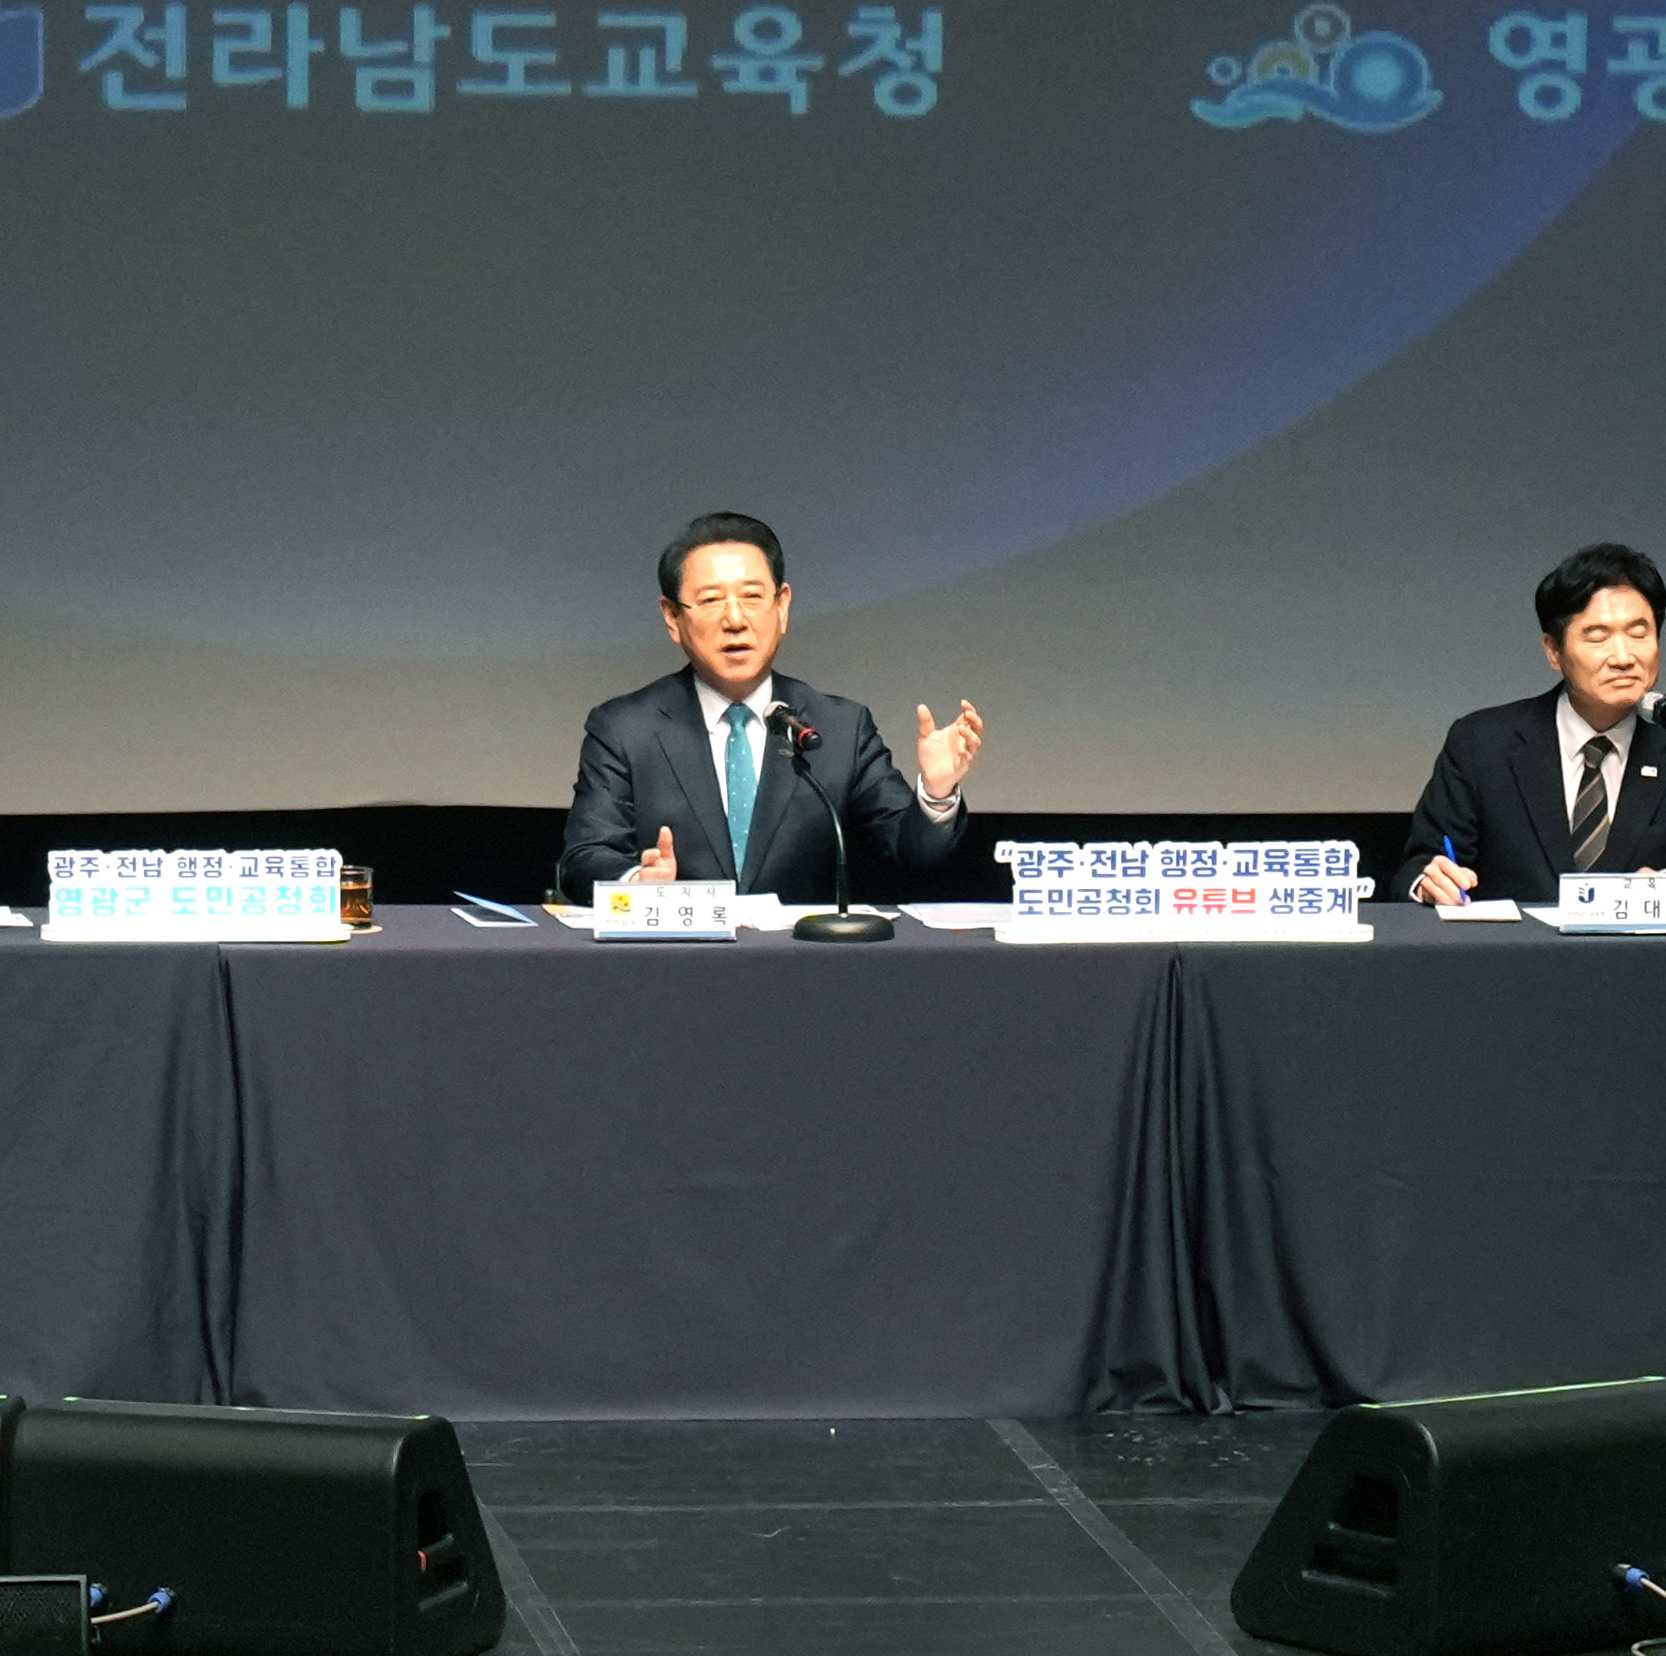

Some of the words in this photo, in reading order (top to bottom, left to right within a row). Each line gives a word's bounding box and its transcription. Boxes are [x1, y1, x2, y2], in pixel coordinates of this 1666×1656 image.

[78, 2, 944, 117] 전라남도교육청
[54, 856, 163, 878] 광주·전남
[177, 856, 337, 878] 행정·교육통합
[1160, 848, 1354, 878] 행정·교육통합
[55, 886, 151, 916] 영광군
[172, 886, 337, 915] 도민공청회
[1017, 888, 1161, 916] 도민공청회
[1172, 888, 1257, 915] 유튜브
